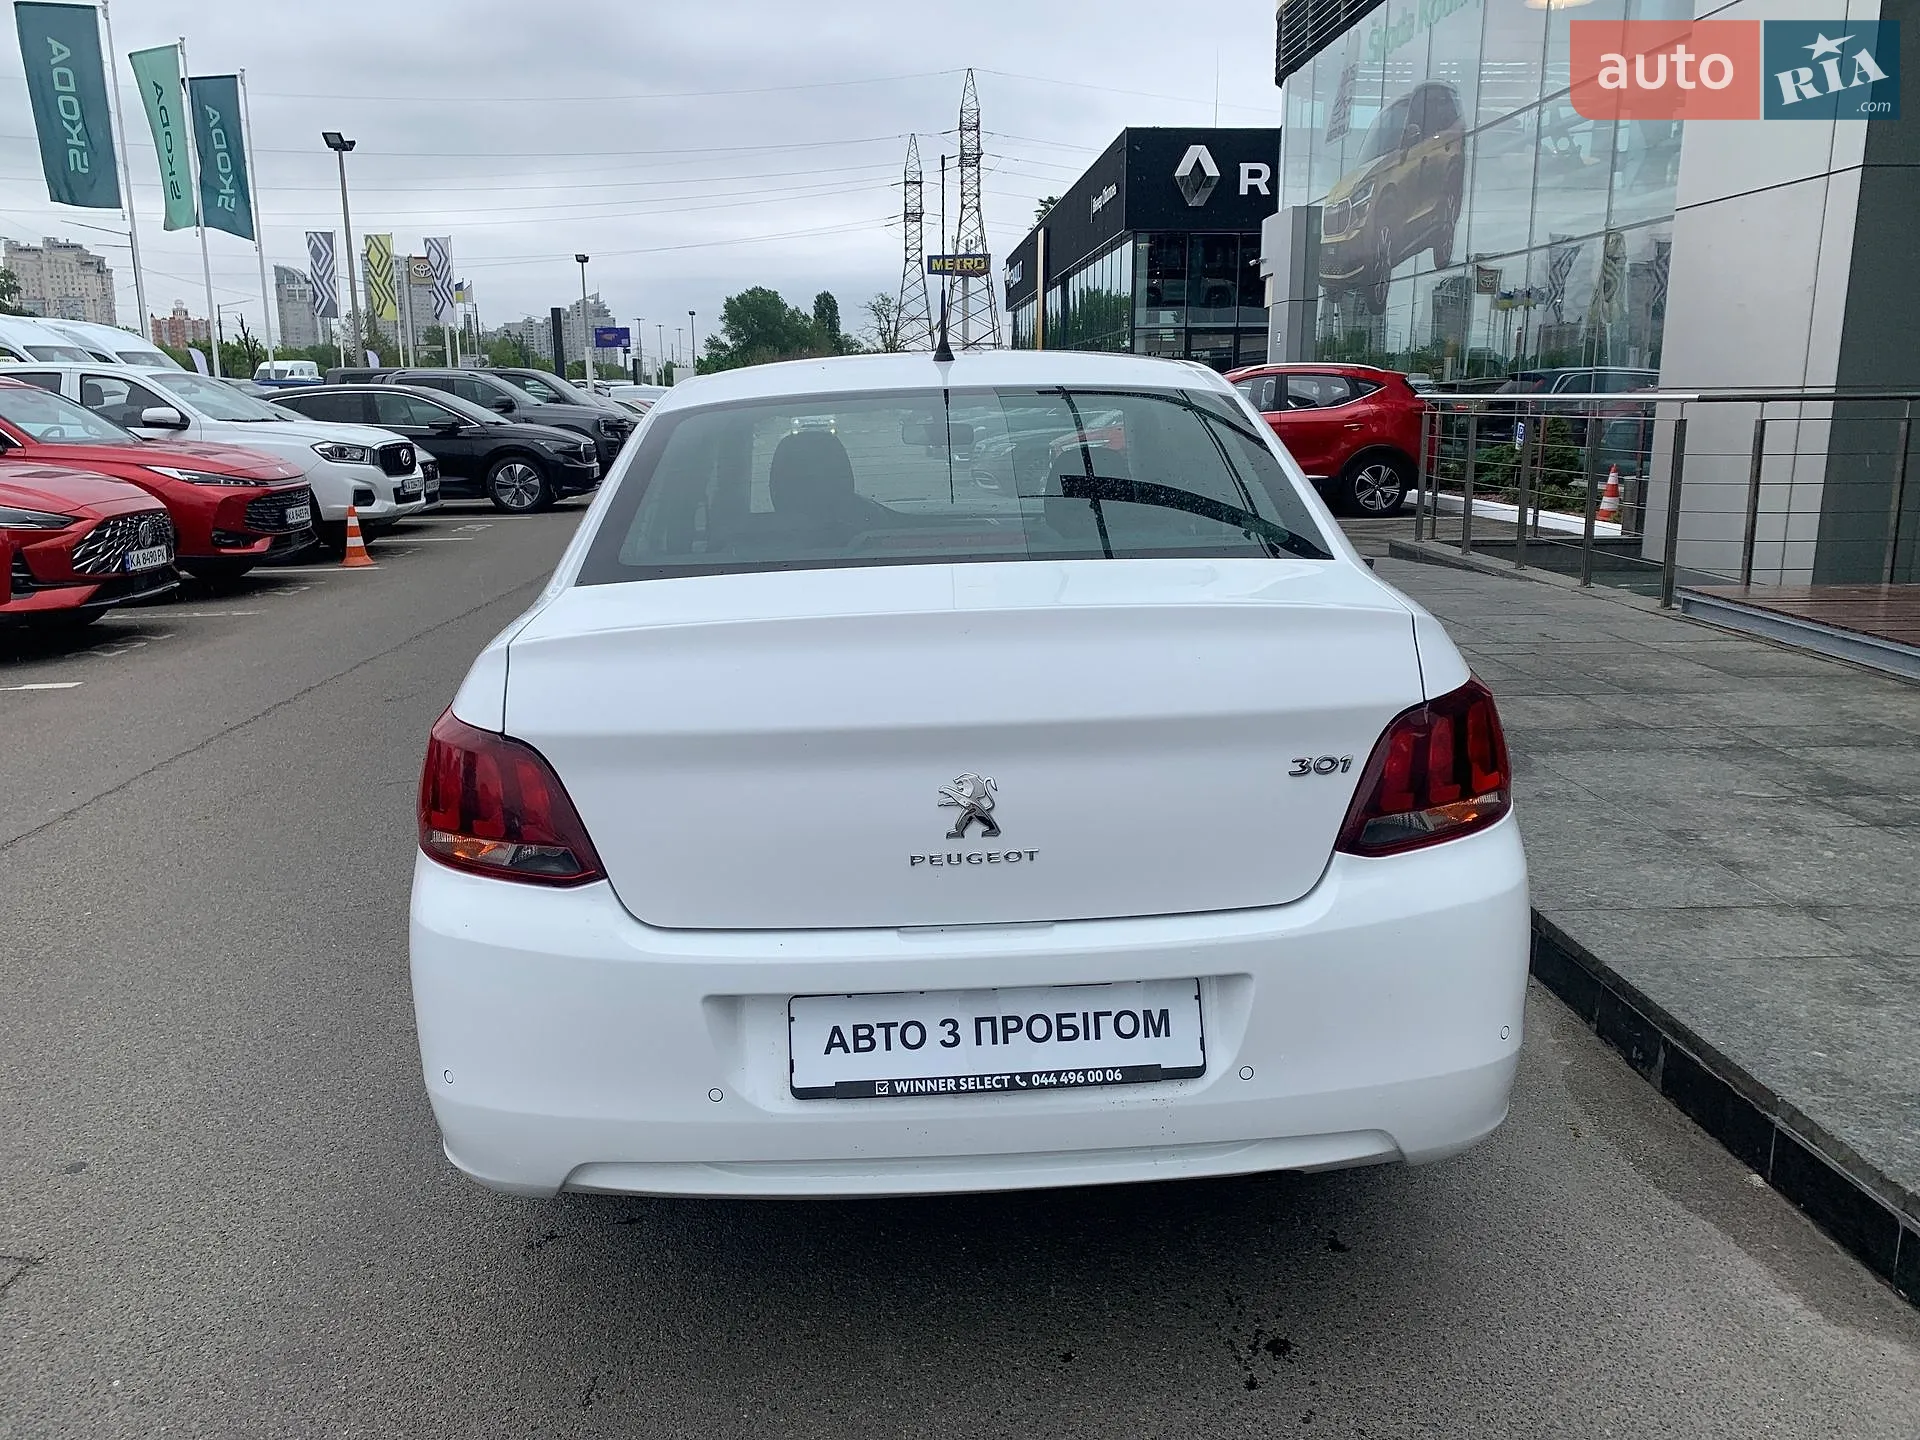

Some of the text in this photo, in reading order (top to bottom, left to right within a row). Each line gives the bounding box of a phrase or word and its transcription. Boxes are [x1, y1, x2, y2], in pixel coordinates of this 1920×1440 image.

[1288, 755, 1353, 777] 301
[910, 848, 1040, 866] PEUGEOT
[824, 1020, 927, 1055] АВТО
[974, 1009, 1171, 1046] ПРОБІГОМ
[894, 1068, 1123, 1094] WINNER SELECT 044 496 00 06
